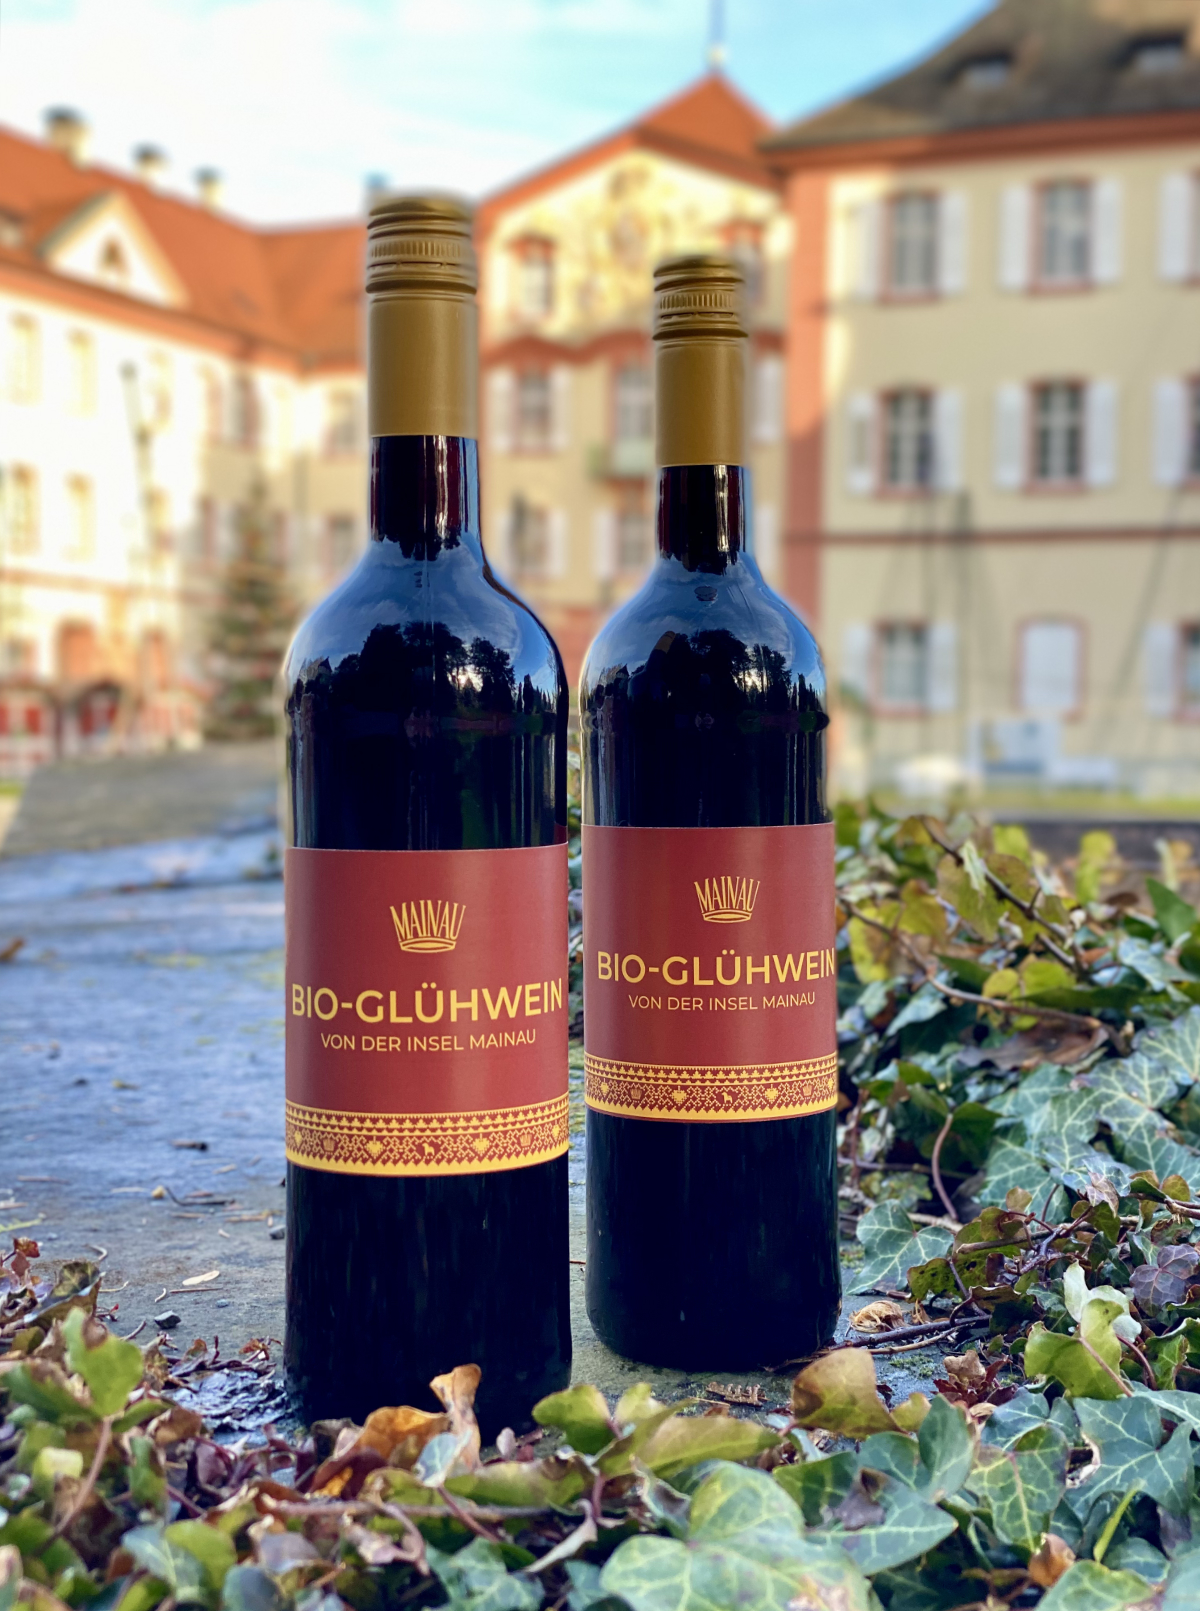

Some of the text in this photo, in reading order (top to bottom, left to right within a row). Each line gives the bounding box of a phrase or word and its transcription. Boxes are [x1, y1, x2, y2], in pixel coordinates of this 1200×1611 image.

[693, 876, 761, 913] MAINAU
[389, 899, 467, 942] MAINAU
[597, 947, 835, 986] BIO-GLÜHWEIN
[292, 977, 563, 1024] BIO-GLÜHWEIN
[628, 991, 816, 1011] VON DER INSEL MAINAU
[320, 1028, 537, 1052] VON DER INSEL MAINAU
